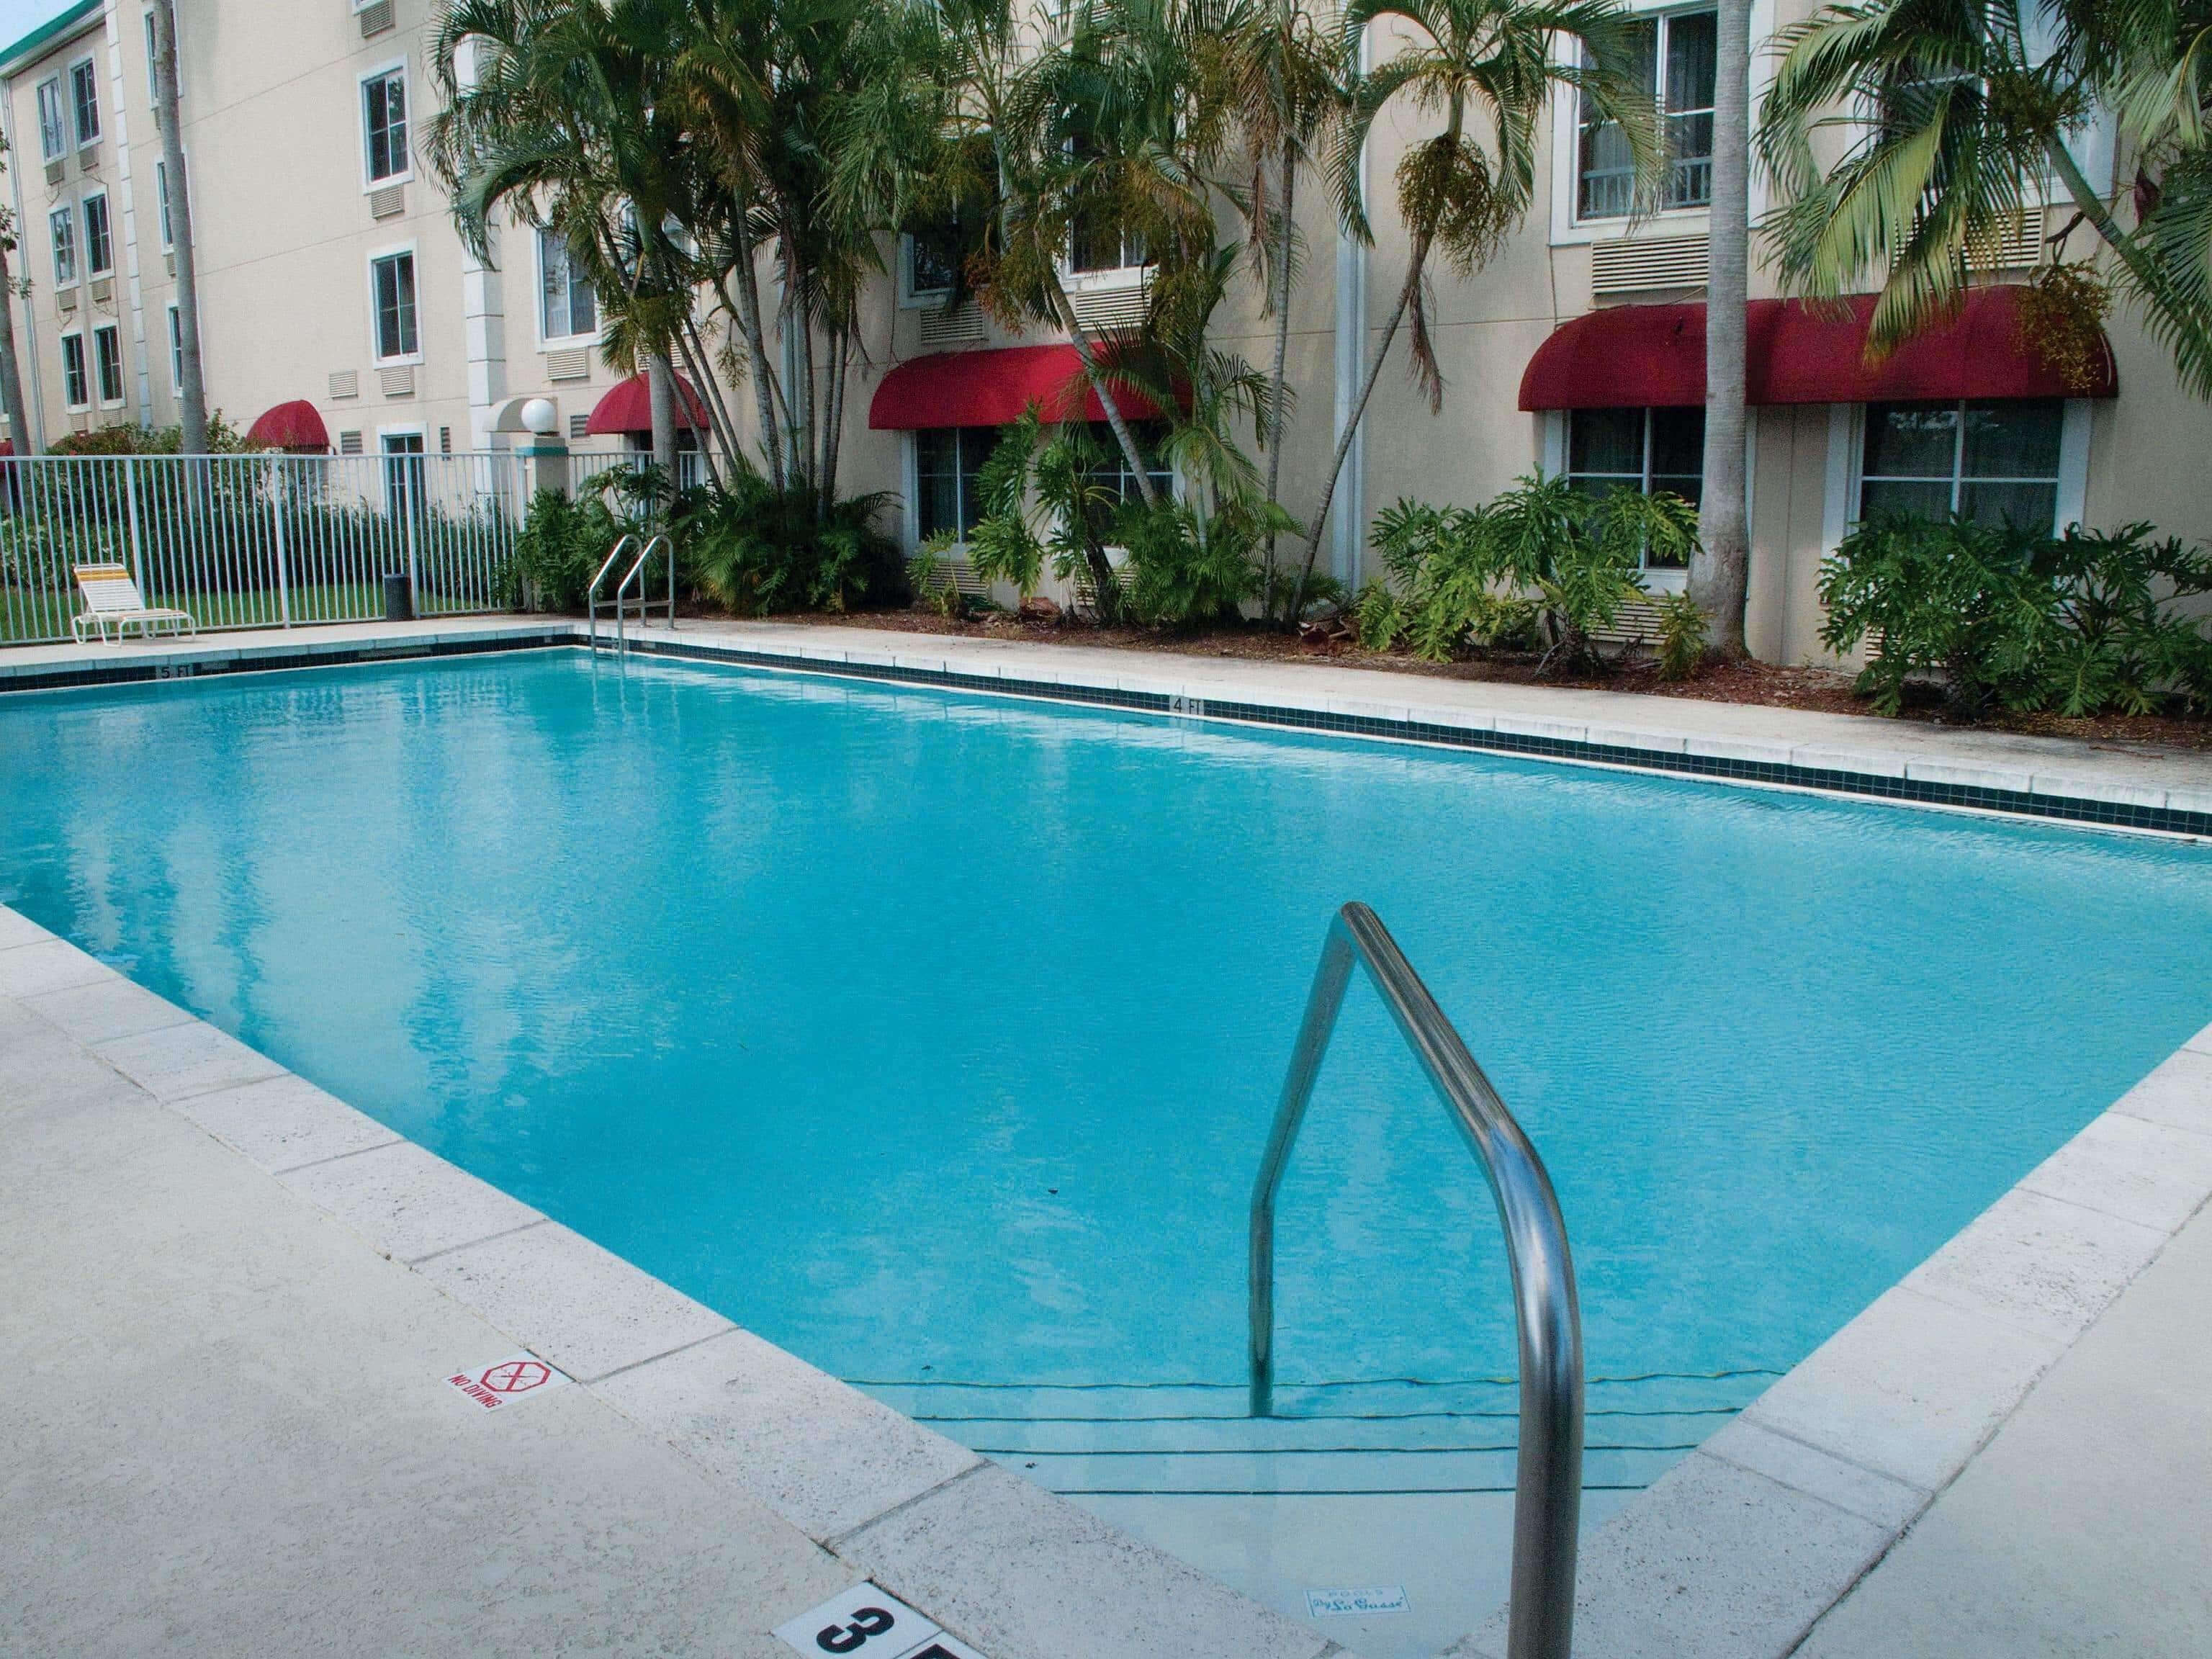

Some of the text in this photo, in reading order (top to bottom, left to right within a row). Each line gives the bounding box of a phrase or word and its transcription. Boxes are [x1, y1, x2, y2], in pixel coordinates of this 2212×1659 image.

[161, 664, 190, 678] 5 FT
[1174, 697, 1201, 715] 4 FT
[448, 1374, 503, 1408] NO DIVING
[816, 1606, 895, 1654] 3
